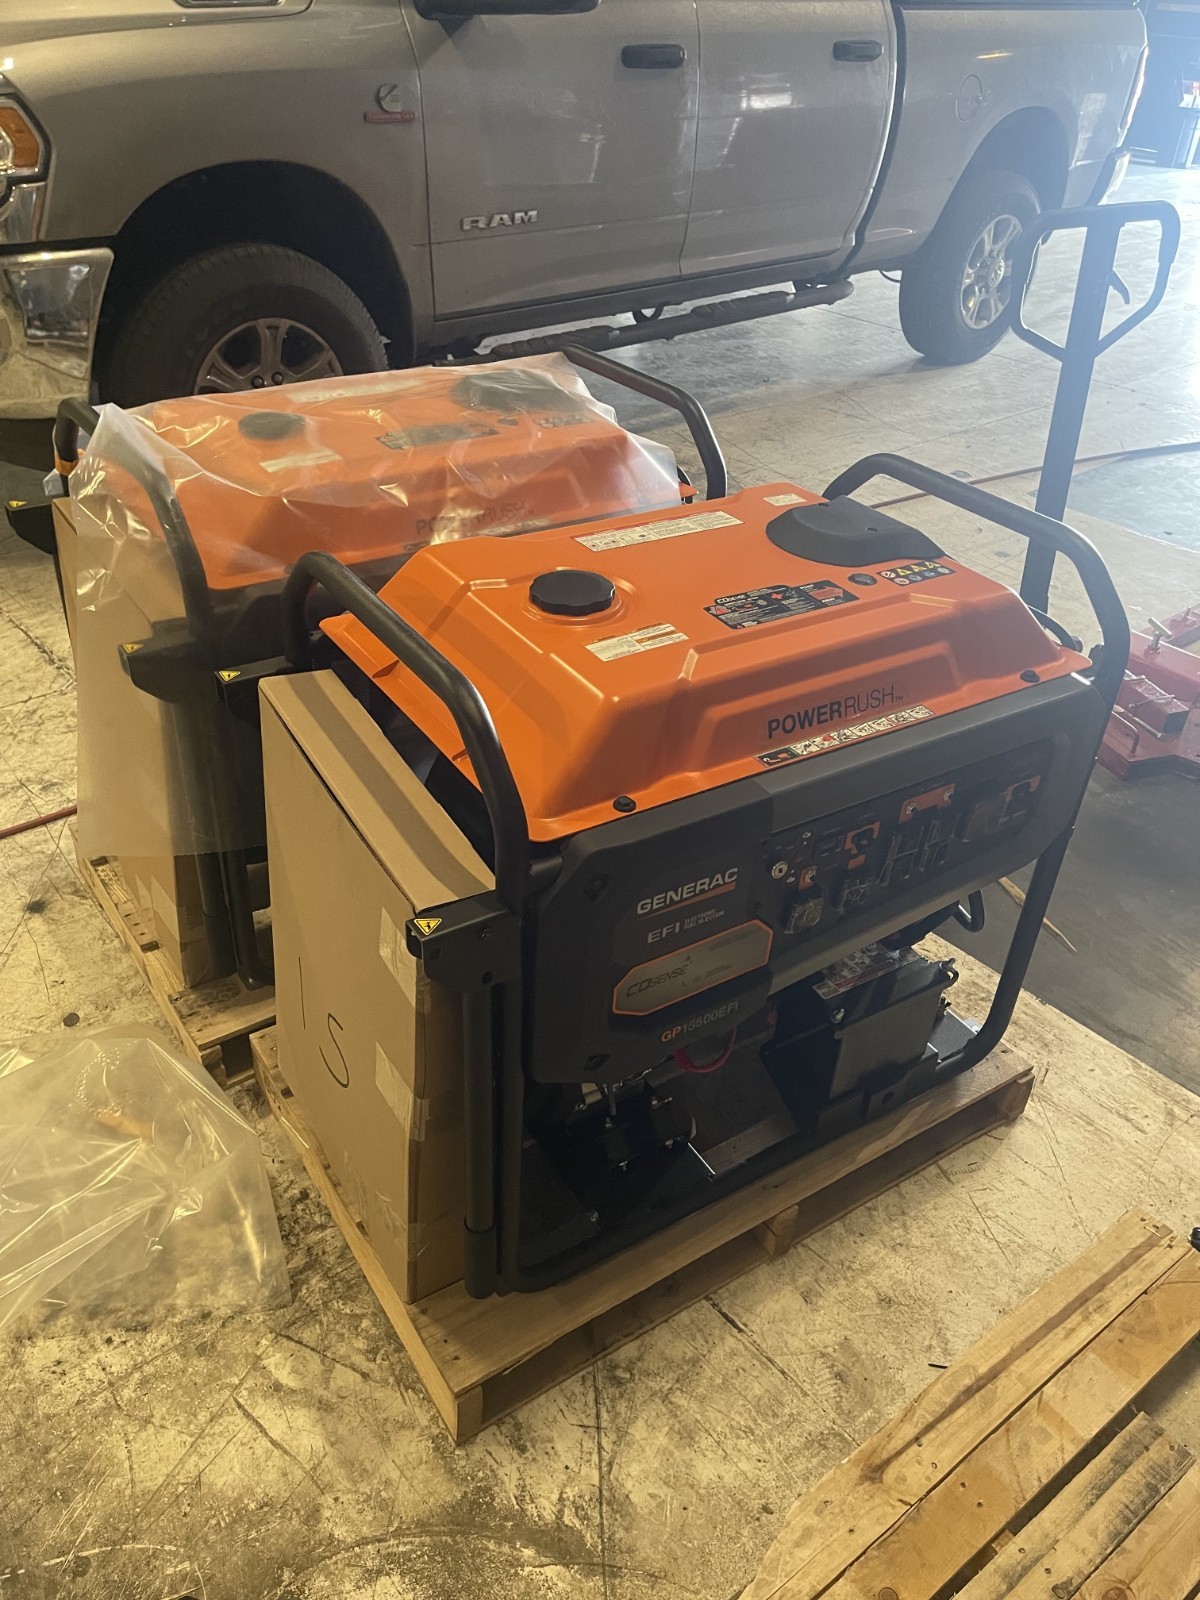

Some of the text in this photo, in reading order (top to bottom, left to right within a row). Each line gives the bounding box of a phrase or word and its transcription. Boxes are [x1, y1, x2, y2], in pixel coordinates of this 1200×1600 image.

[462, 209, 538, 231] RAM
[636, 867, 738, 915] GENERAC
[647, 922, 680, 944] EFI
